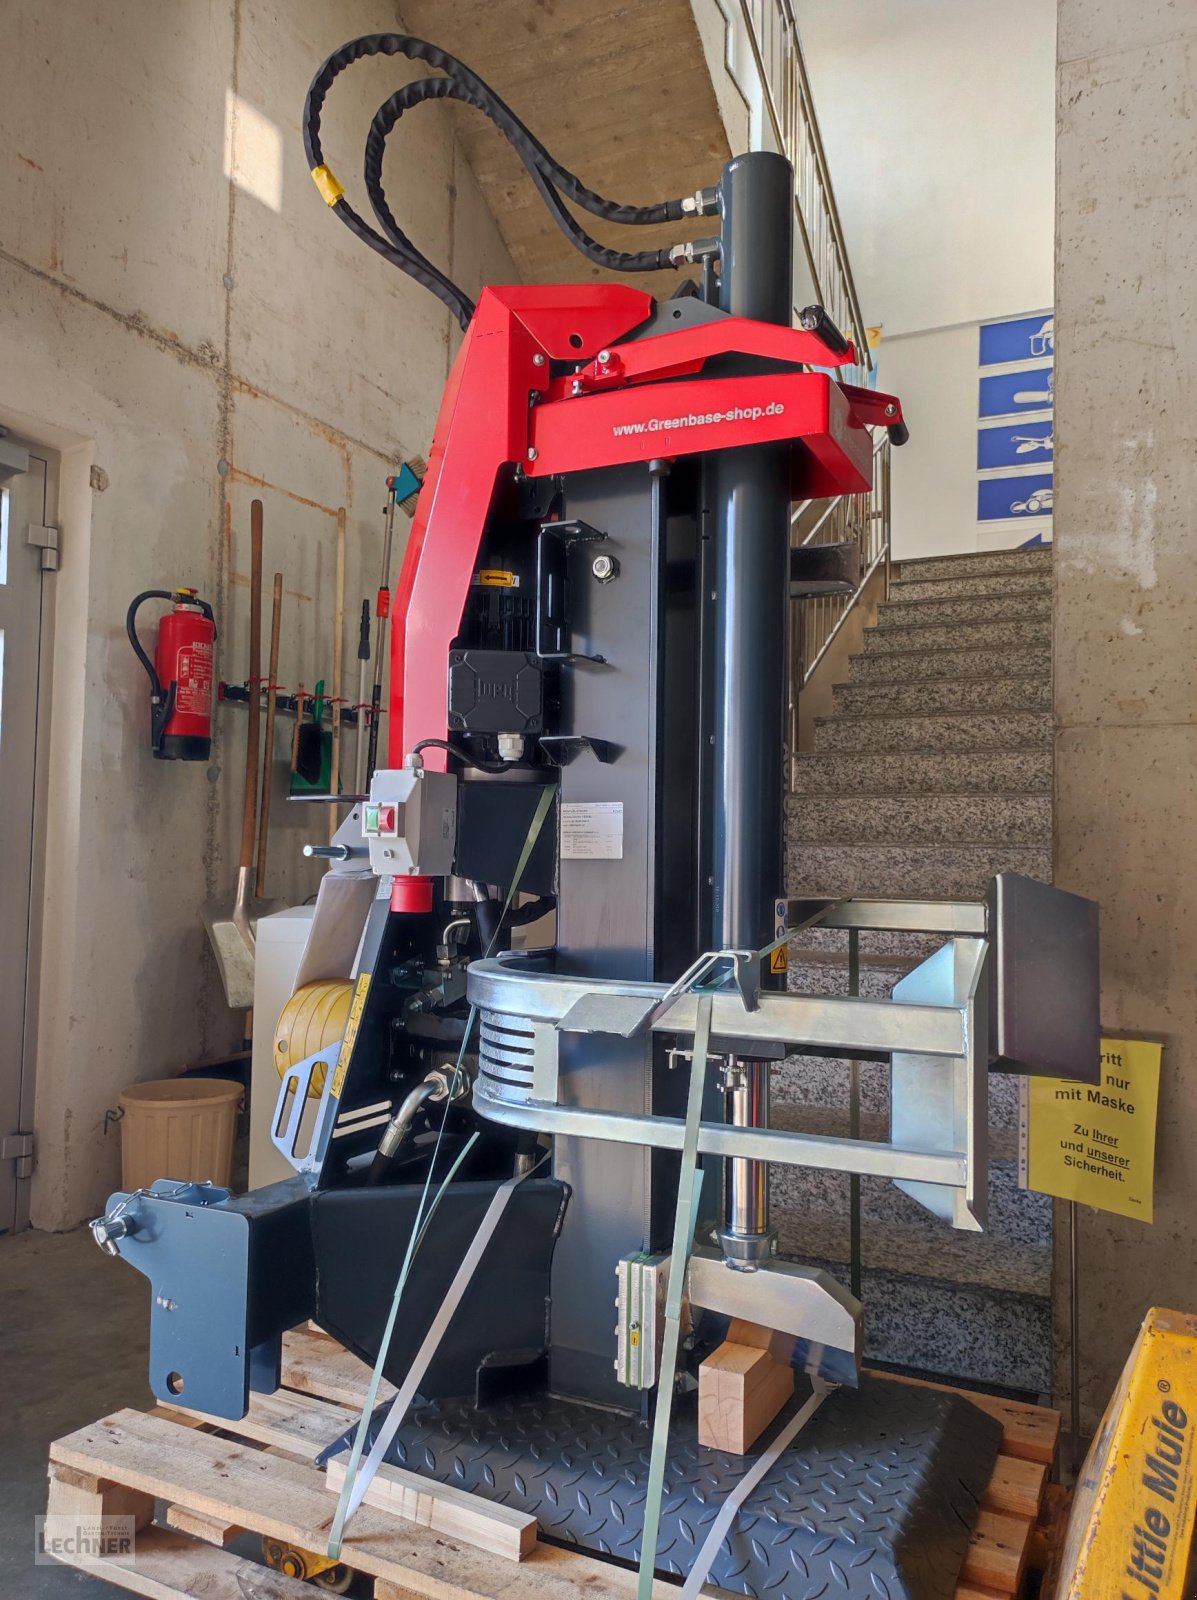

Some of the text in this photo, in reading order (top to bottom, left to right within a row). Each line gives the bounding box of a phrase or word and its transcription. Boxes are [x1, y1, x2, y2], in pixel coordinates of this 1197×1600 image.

[613, 402, 784, 437] www.Greenbase-shop.de
[1100, 1052, 1122, 1067] ritt
[1106, 1073, 1131, 1090] nur
[1055, 1088, 1135, 1114] mit Maske
[1073, 1123, 1118, 1147] Zu Ihrer
[1060, 1139, 1130, 1168] und unserer
[1063, 1155, 1125, 1182] Sicherheit.
[1121, 1507, 1171, 1600] ittle
